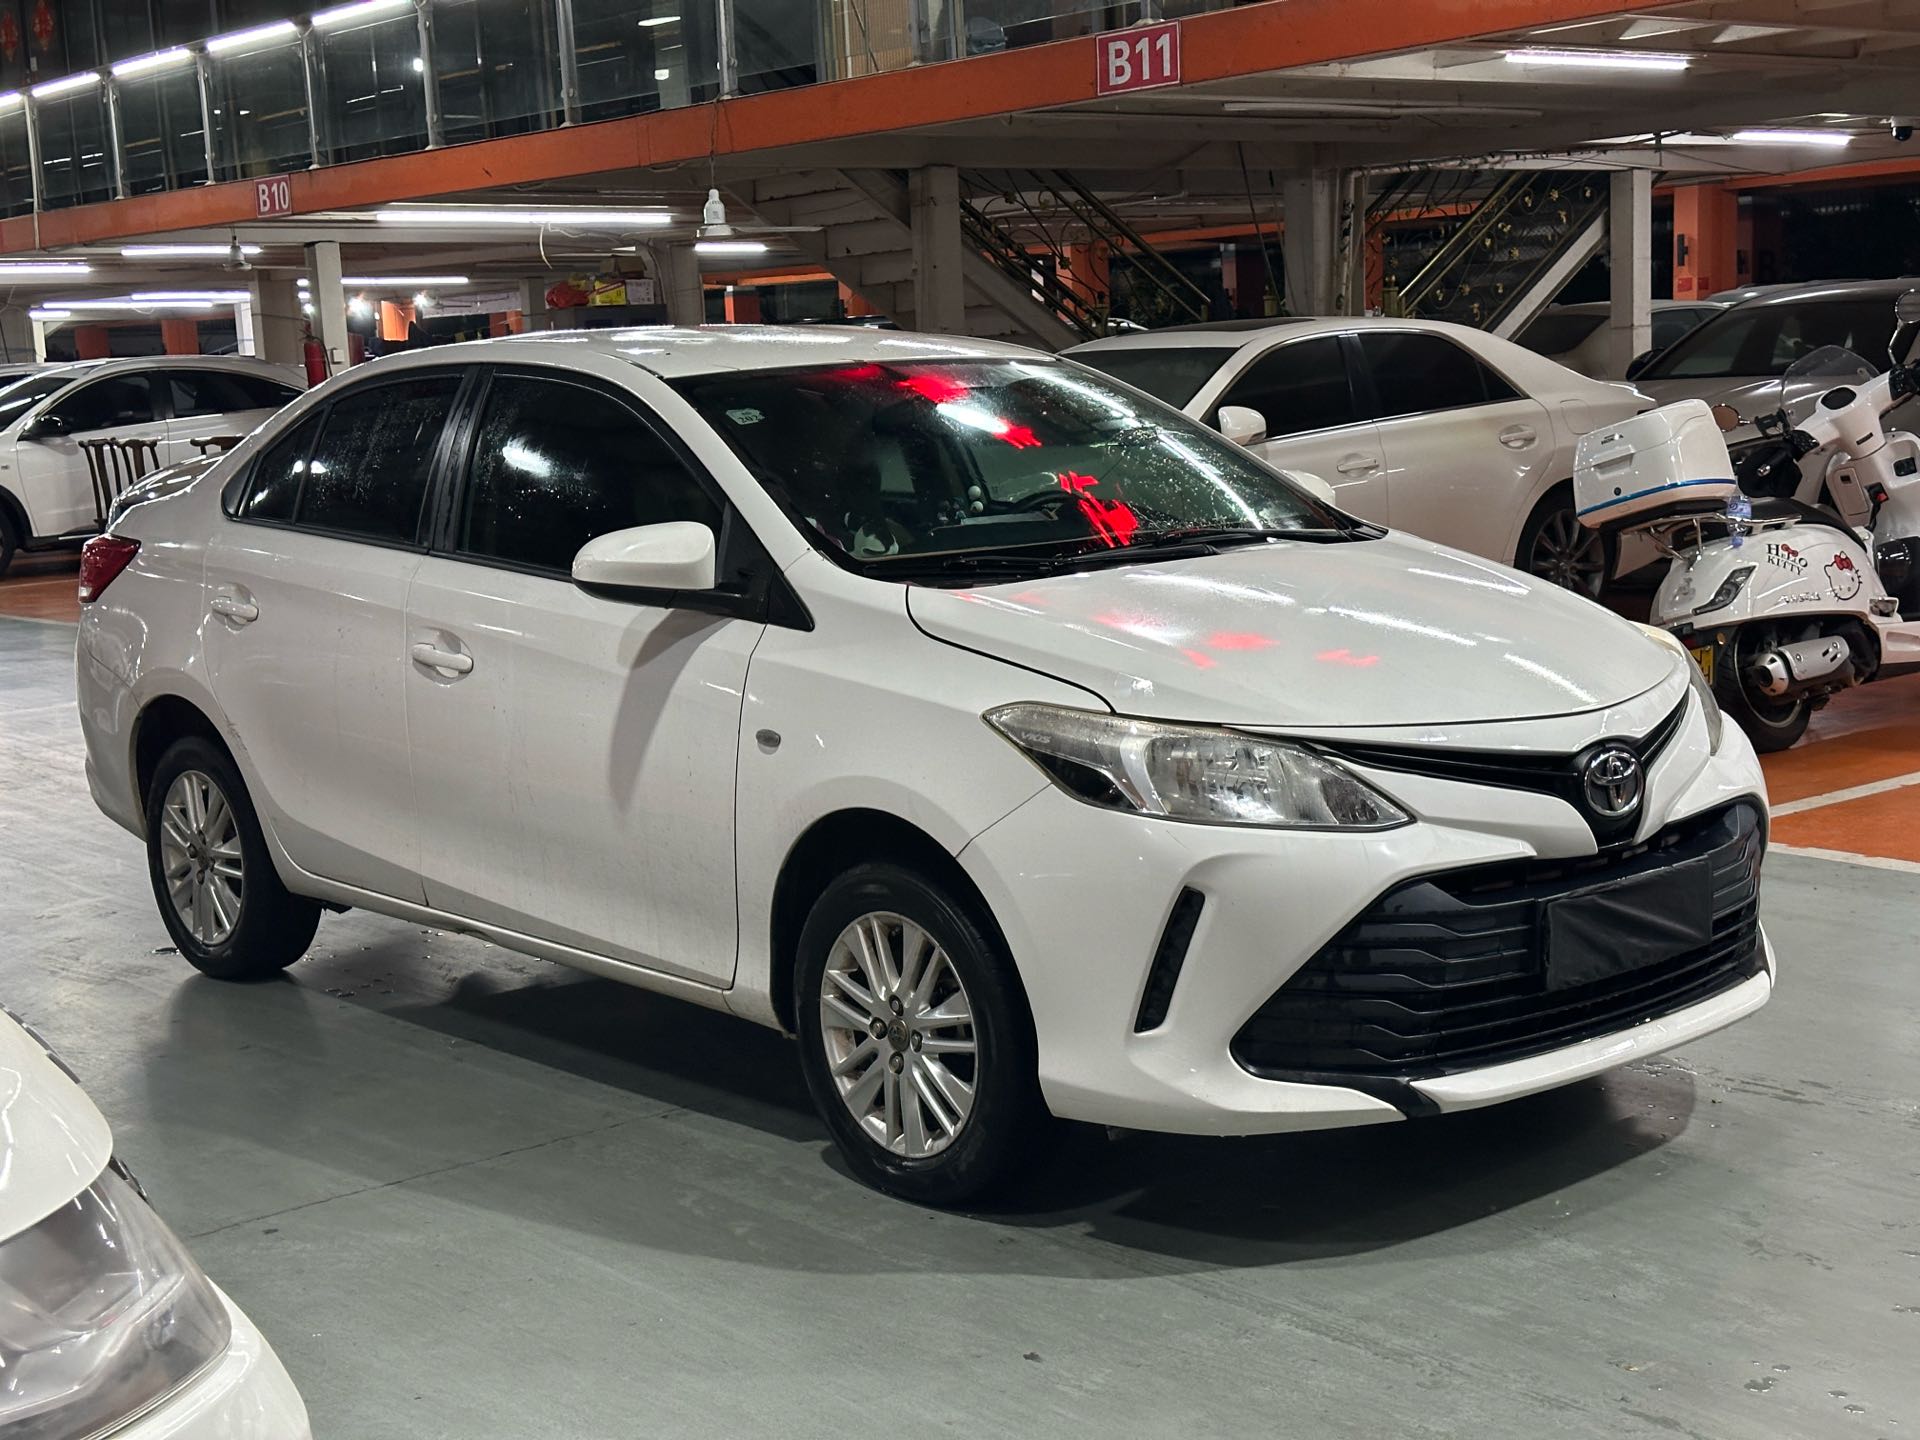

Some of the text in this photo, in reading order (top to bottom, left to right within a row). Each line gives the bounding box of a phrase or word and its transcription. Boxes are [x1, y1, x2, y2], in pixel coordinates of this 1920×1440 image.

[1108, 33, 1171, 86] B11
[258, 181, 289, 212] B10
[1767, 555, 1804, 576] KITTY
